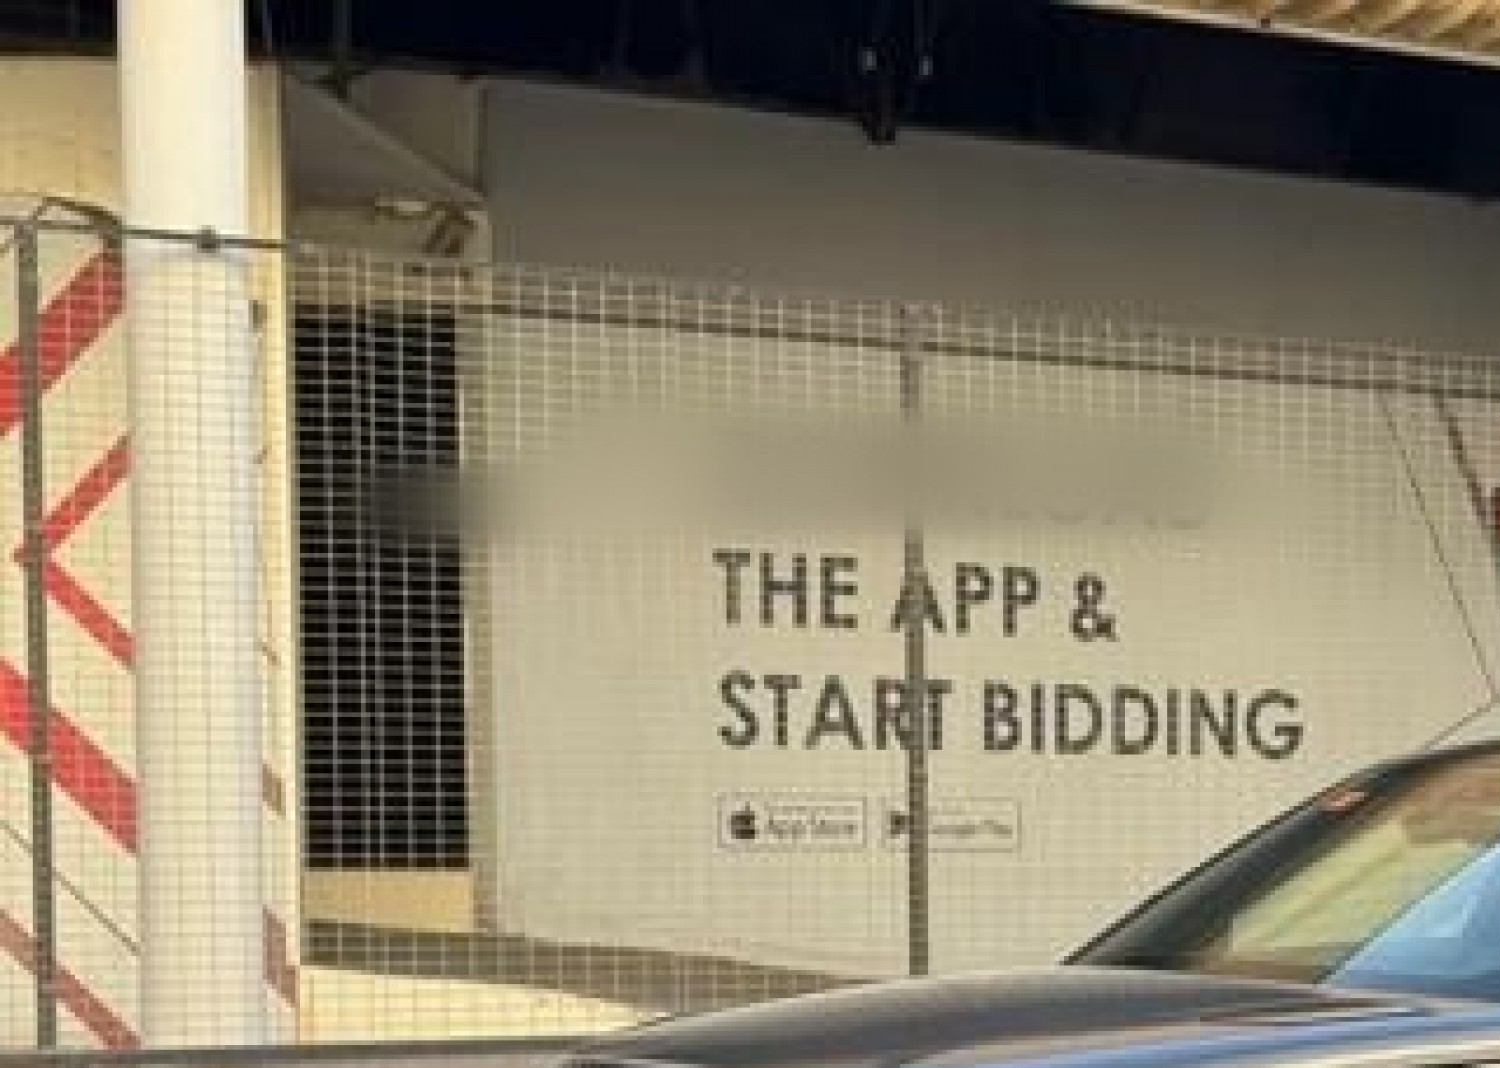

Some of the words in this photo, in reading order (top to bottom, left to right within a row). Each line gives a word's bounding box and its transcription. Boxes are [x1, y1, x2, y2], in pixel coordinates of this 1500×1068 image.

[713, 550, 857, 628] THE
[890, 562, 1040, 637] APP
[1069, 571, 1119, 642] &
[717, 670, 955, 750] START
[983, 679, 1303, 759] BIDDING
